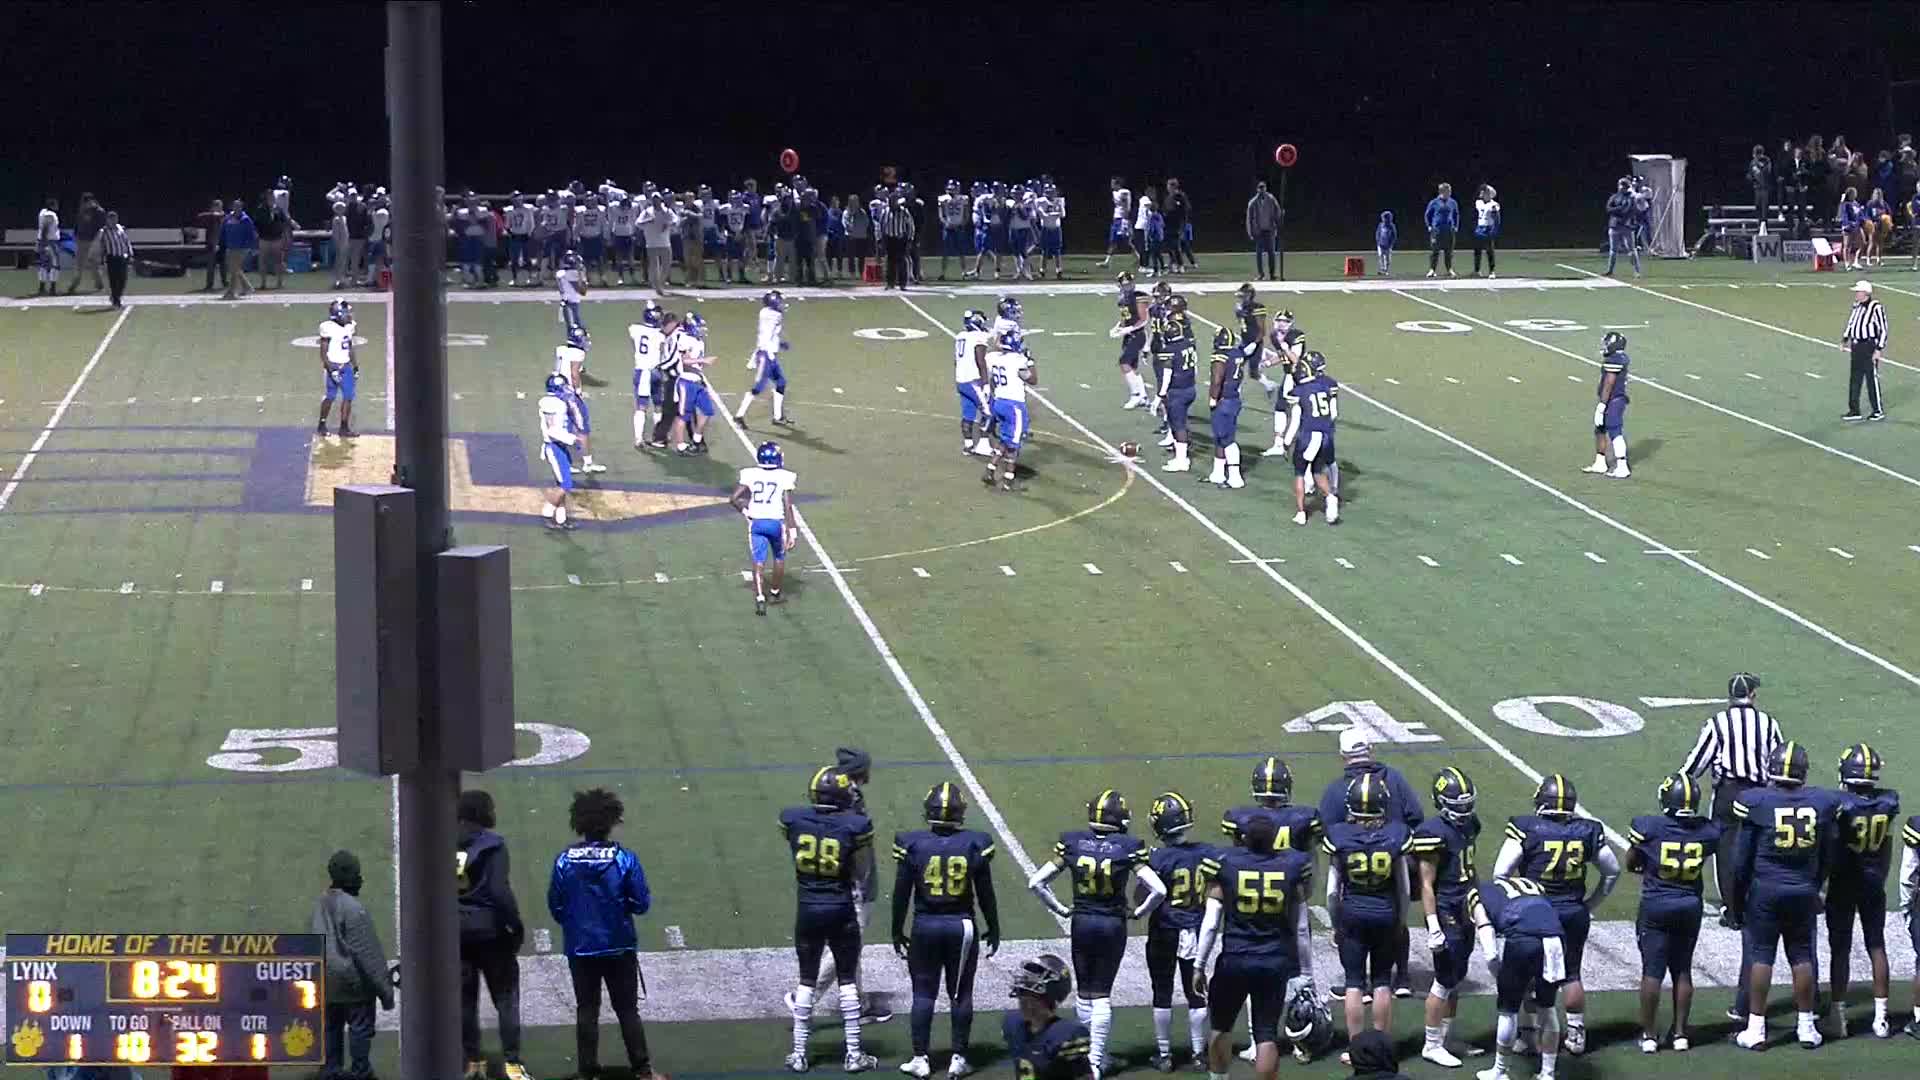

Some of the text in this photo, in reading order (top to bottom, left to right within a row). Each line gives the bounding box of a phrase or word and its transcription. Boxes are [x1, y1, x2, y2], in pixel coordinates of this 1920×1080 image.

[1757, 240, 1776, 257] W
[639, 335, 649, 354] 6
[991, 365, 1008, 389] 66
[1309, 392, 1330, 418] 15
[753, 481, 777, 505] 27
[1774, 807, 1815, 849] 53
[1847, 814, 1888, 853] 30
[796, 835, 840, 878] 28
[924, 855, 968, 897] 48
[1660, 842, 1703, 882] 52
[1076, 856, 1113, 897] 31
[1238, 871, 1287, 914] 55
[1494, 876, 1545, 899] 10
